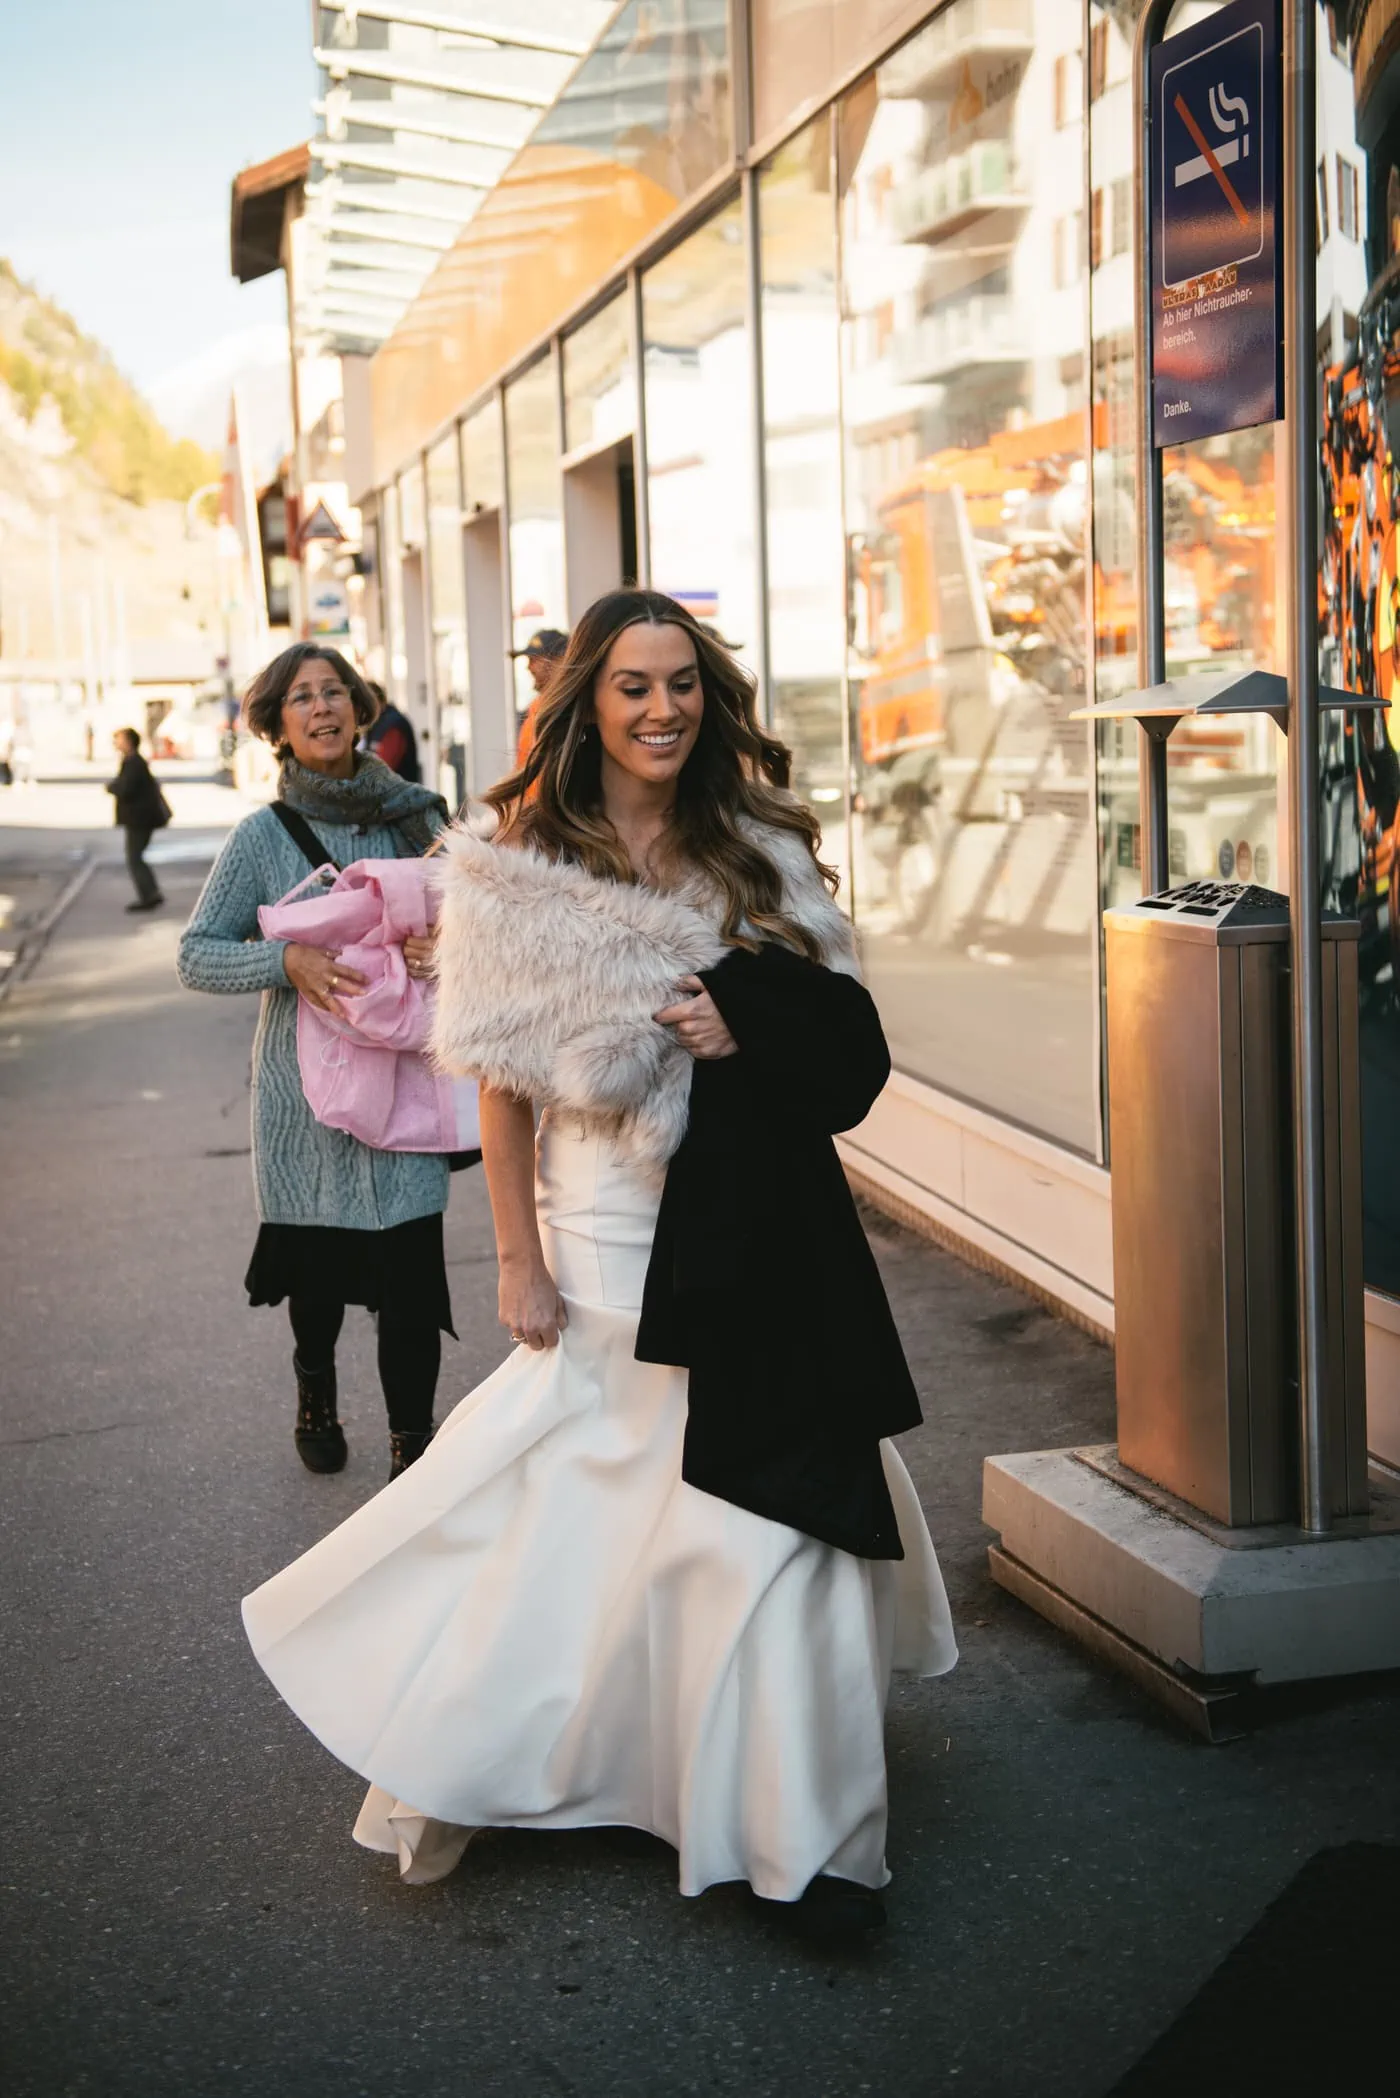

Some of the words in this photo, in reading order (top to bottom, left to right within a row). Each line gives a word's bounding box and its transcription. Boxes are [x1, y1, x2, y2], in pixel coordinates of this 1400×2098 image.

[1163, 313, 1175, 328] Ab
[1176, 307, 1192, 323] hier
[1194, 288, 1252, 317] Nichtraucher-
[1163, 328, 1196, 349] bereich.
[1163, 399, 1192, 418] Danke.
